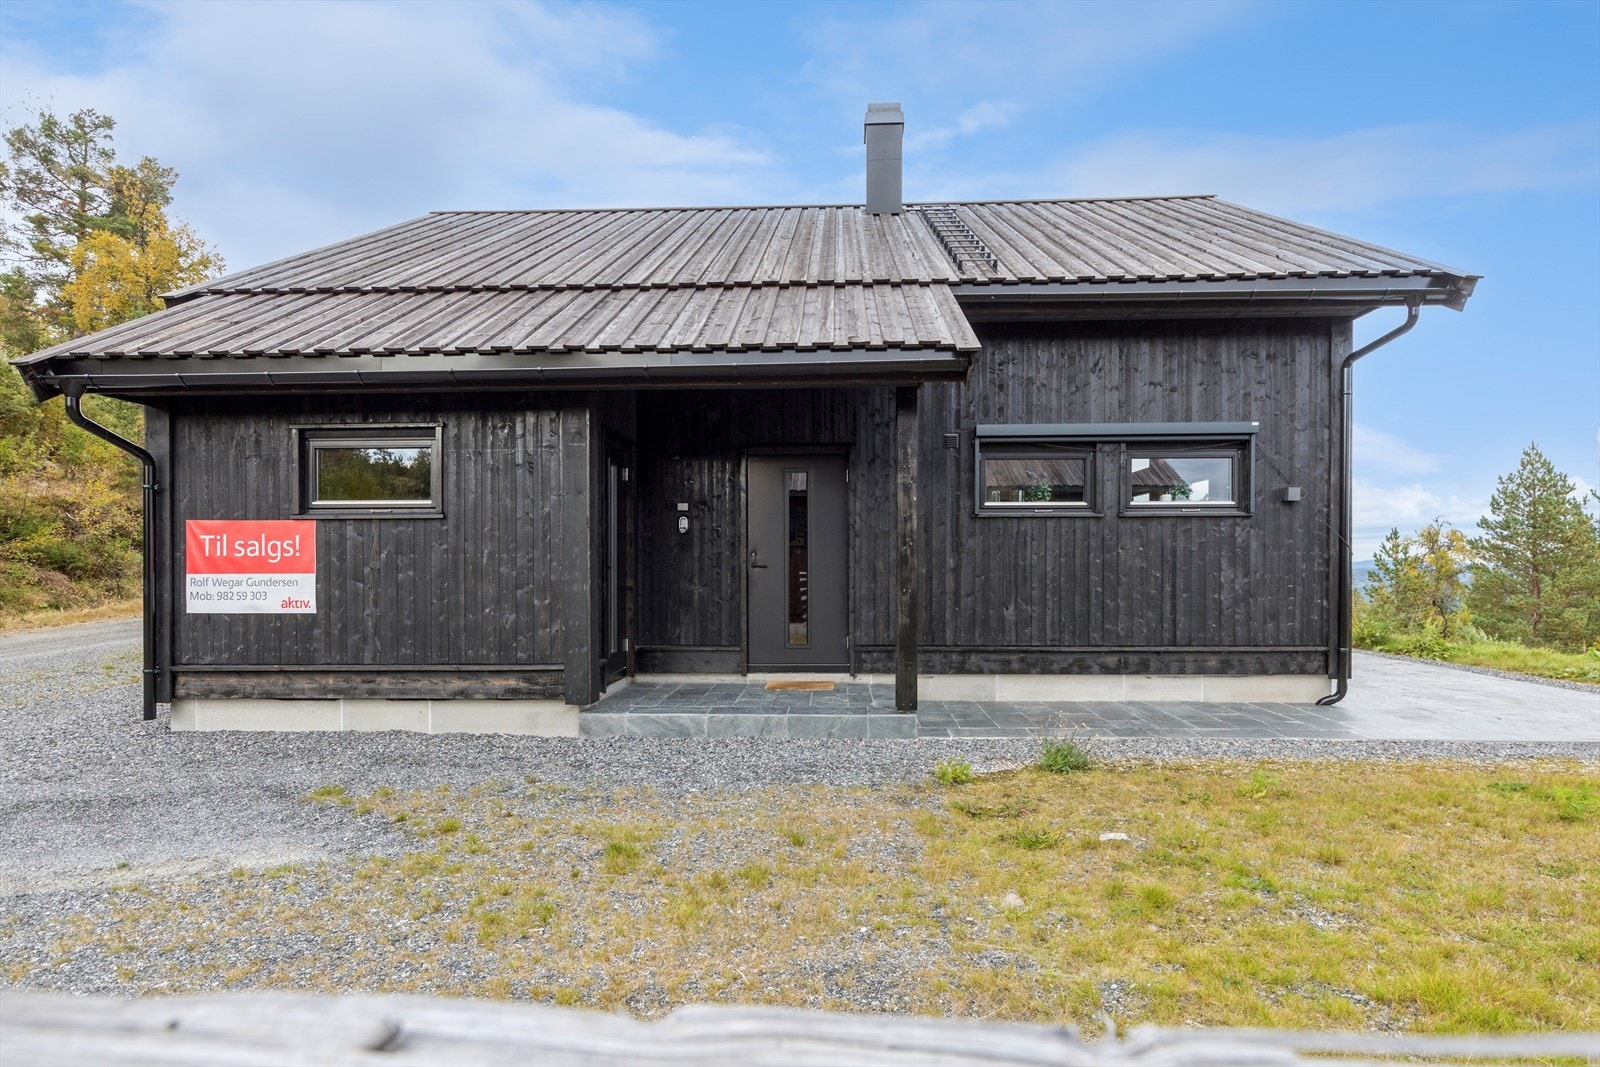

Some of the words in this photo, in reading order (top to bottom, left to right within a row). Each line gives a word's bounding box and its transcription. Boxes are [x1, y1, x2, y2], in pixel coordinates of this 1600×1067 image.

[199, 533, 227, 557] Til
[234, 533, 300, 563] salgs!
[190, 577, 210, 587] Rolf
[212, 577, 244, 590] Wegar
[246, 577, 299, 587] Gundersen
[189, 591, 215, 601] Mob:
[216, 591, 234, 601] 982
[236, 591, 248, 601] 59
[250, 591, 268, 601] 303
